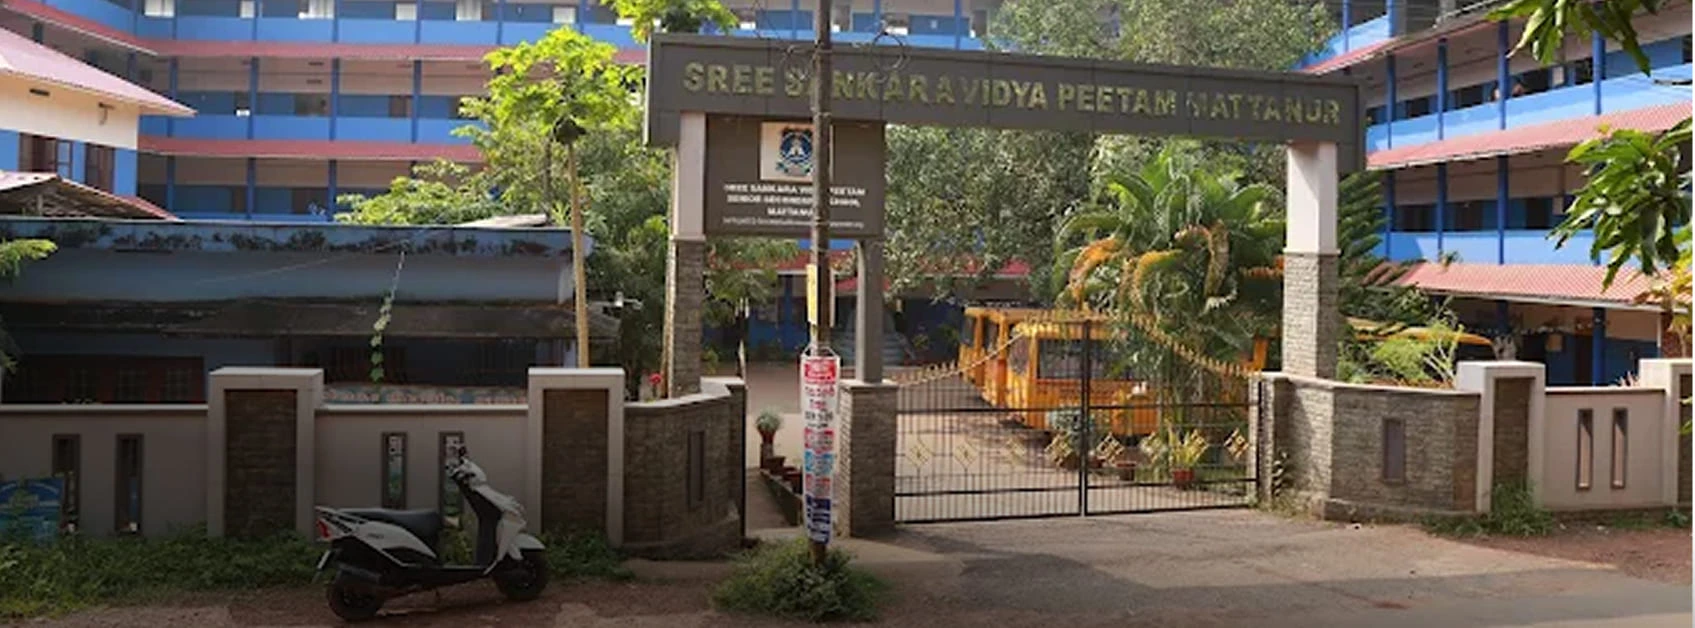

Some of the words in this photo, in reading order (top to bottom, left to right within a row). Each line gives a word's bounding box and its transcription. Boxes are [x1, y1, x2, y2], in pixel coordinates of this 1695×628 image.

[683, 62, 775, 94] SREE
[961, 77, 1048, 110] VIDYA
[1058, 83, 1177, 116] PEETAM
